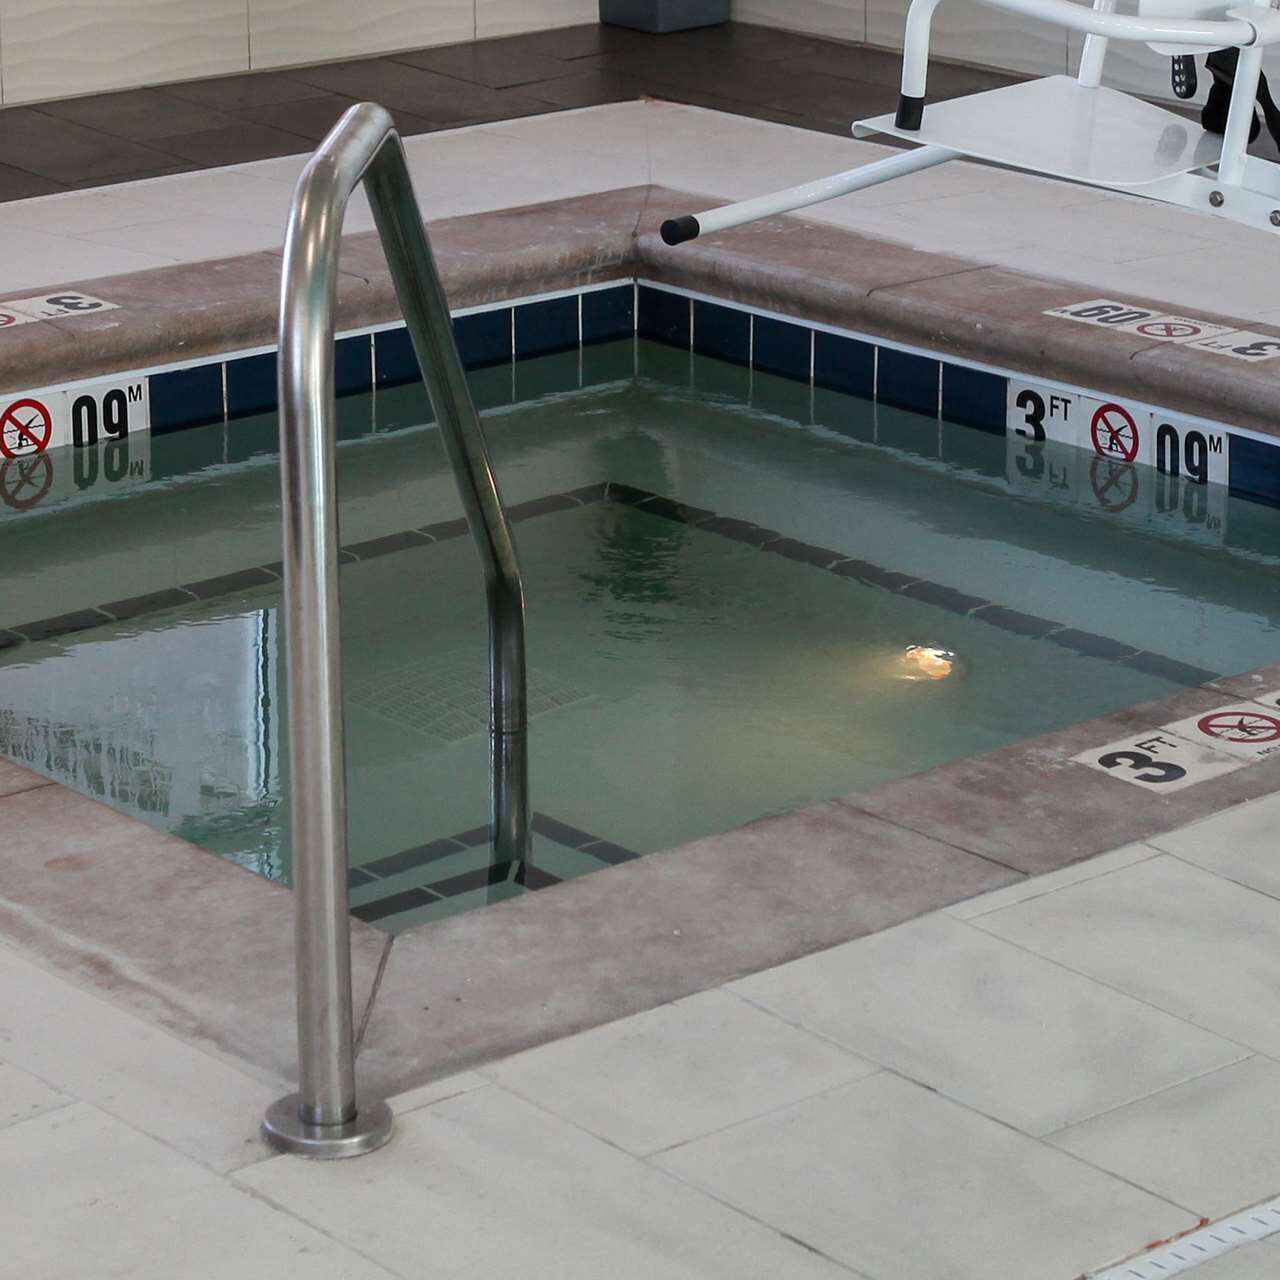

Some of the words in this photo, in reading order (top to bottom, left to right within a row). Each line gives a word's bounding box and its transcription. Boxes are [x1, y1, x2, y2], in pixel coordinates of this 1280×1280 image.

[46, 296, 103, 310] 3
[127, 384, 143, 403] M
[1015, 389, 1047, 442] 3
[1050, 394, 1072, 421] FT
[1208, 434, 1223, 454] M
[1134, 736, 1177, 754] FT
[1097, 751, 1187, 783] 3
